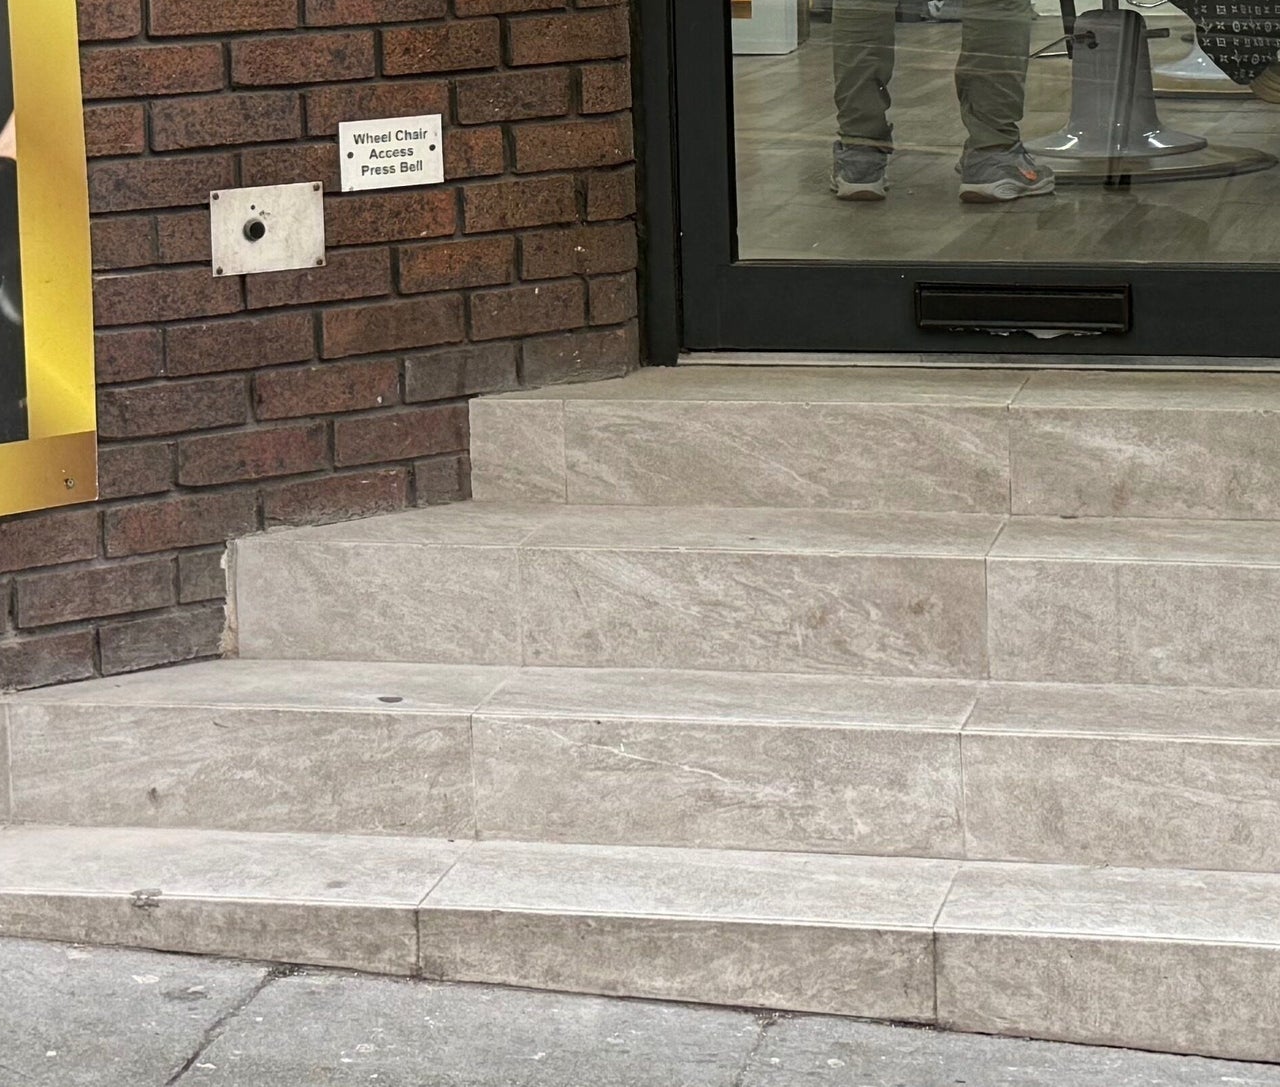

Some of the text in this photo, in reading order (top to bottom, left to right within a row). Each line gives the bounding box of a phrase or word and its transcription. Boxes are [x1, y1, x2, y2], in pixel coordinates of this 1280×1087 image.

[353, 128, 428, 145] Wheel Chair
[369, 147, 414, 159] Access
[361, 160, 423, 176] Press Bell
